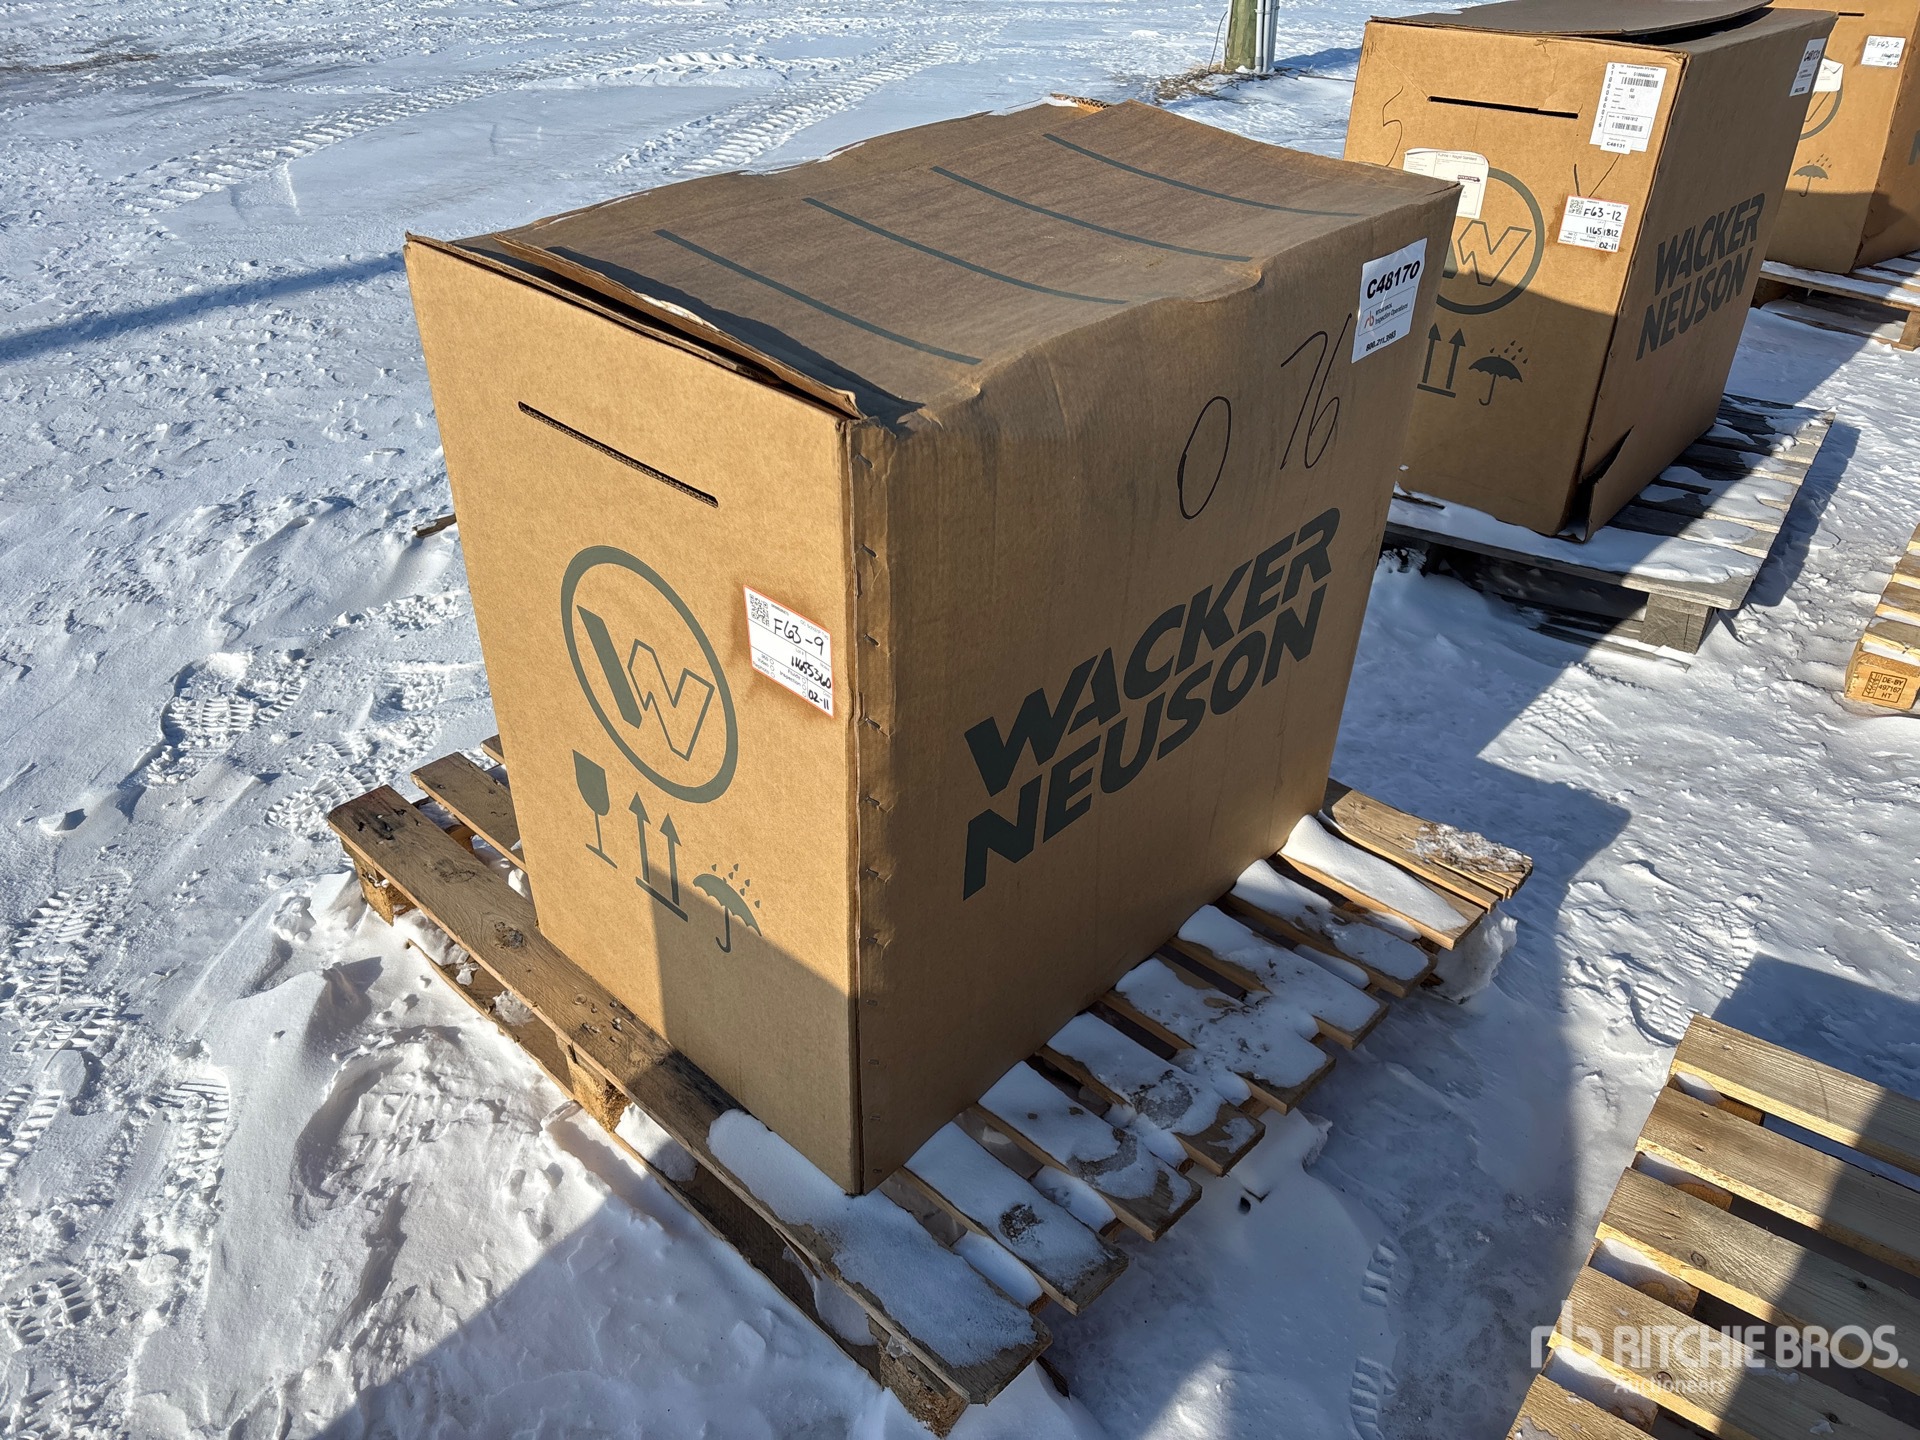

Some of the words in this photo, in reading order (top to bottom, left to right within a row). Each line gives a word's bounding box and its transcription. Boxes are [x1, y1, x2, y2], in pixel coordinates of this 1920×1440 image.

[1583, 206, 1622, 222] F63-12
[1585, 226, 1619, 238] 11651812
[1598, 241, 1617, 250] 02-11
[1654, 192, 1766, 297] WACKER
[1367, 260, 1421, 299] C48170
[1635, 248, 1754, 362] NEUSON
[774, 617, 825, 656] F63-9
[963, 506, 1342, 798] WACKER
[808, 689, 830, 710] 02-11
[963, 582, 1329, 901] NEUSON
